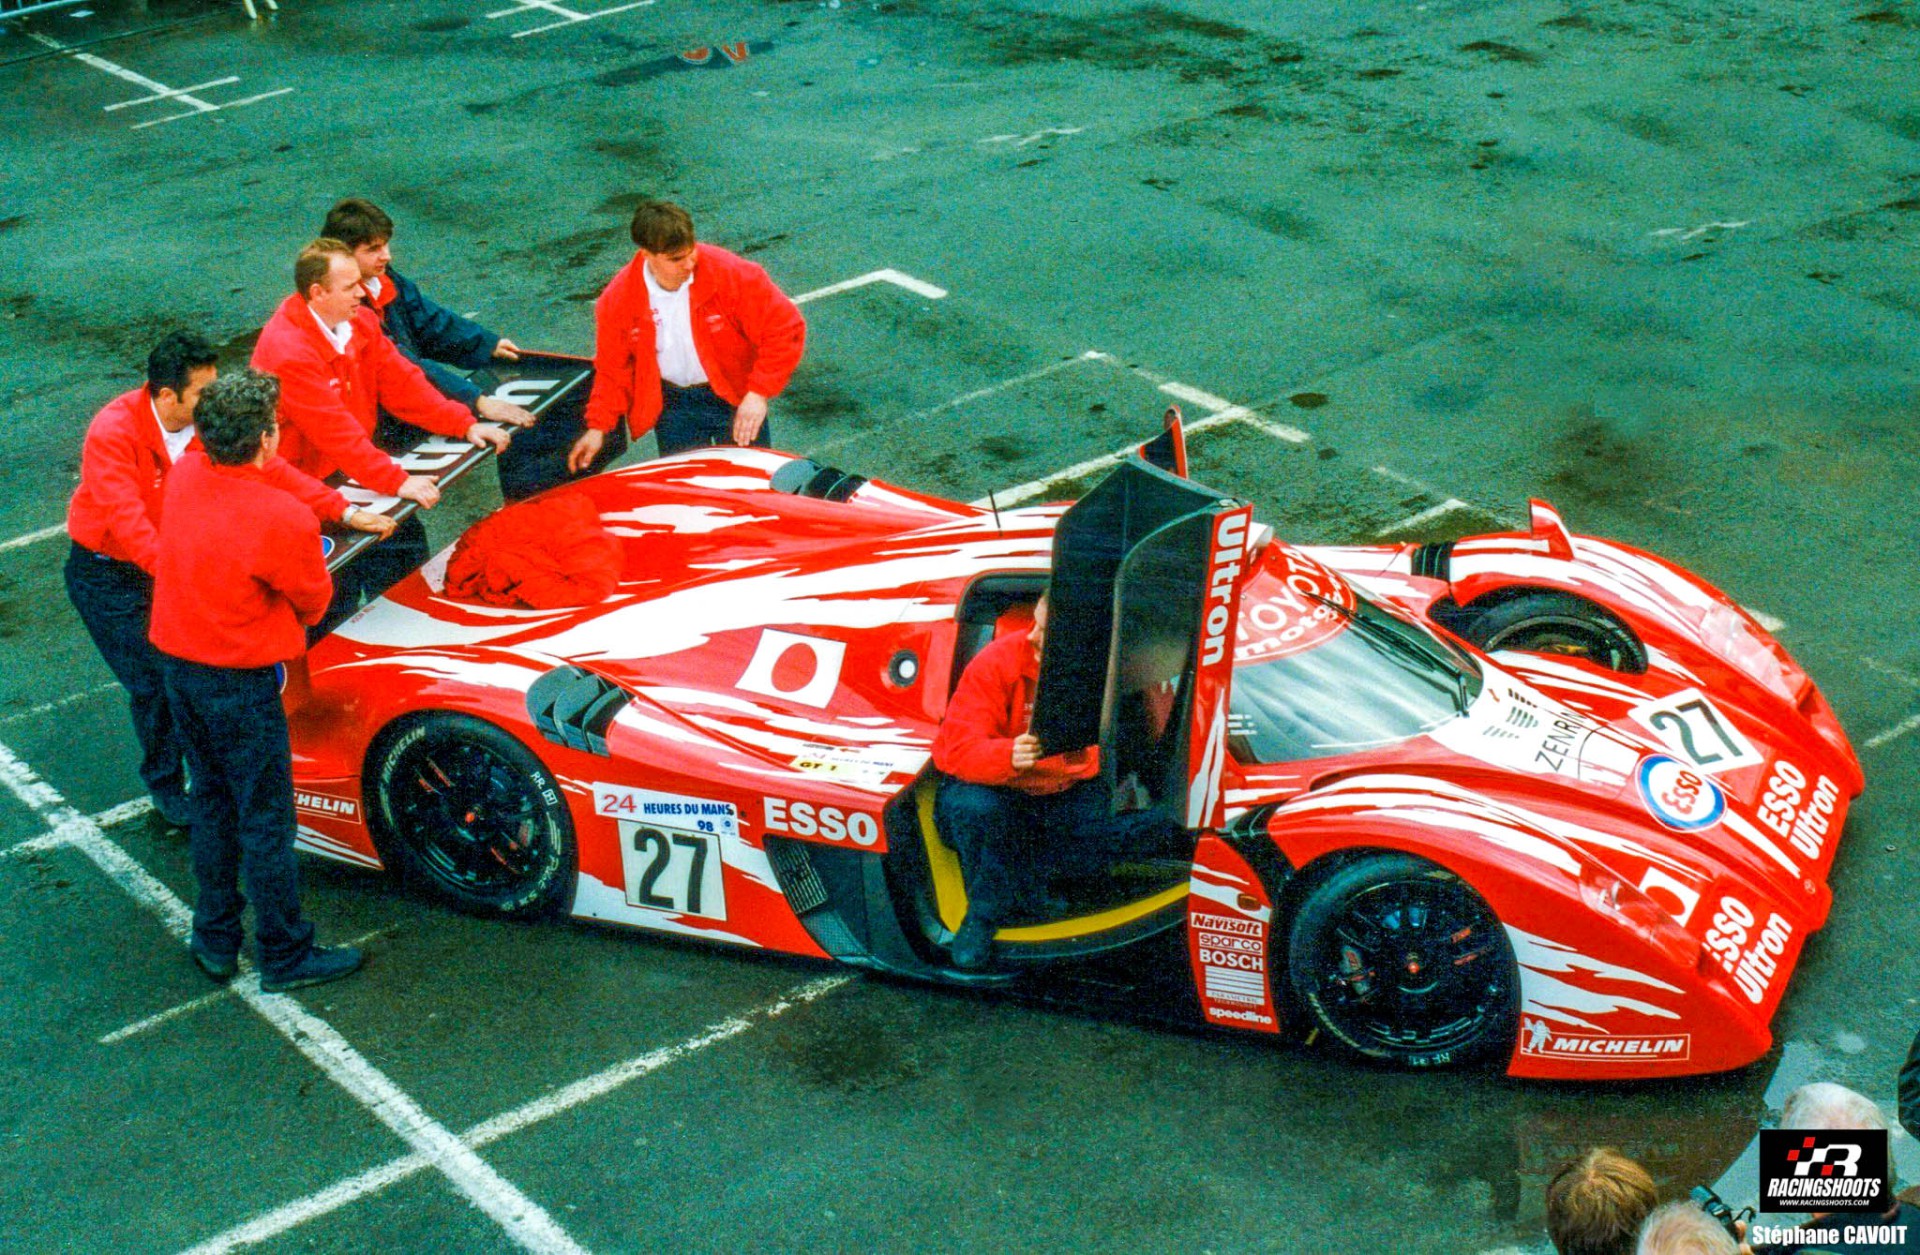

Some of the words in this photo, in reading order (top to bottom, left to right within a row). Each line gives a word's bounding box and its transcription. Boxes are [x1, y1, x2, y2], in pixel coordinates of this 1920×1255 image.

[1201, 513, 1247, 667] Ultron
[1649, 698, 1743, 765] 27
[294, 792, 356, 815] HELIN
[602, 794, 638, 813] 24
[643, 803, 682, 815] HEURES
[684, 804, 699, 815] DU
[701, 803, 731, 816] MANS
[1757, 760, 1806, 839] ESSO
[697, 819, 714, 832] 98
[763, 796, 879, 847] ESSO
[1789, 774, 1839, 860] Ultron
[634, 828, 709, 914] 27
[1193, 914, 1261, 935] Navisoft
[1200, 933, 1262, 951] sparco
[1199, 948, 1264, 971] BOSCH
[1733, 912, 1793, 1004] Ultron
[1209, 1006, 1273, 1025] speedline
[1553, 1037, 1685, 1054] MICHELIN
